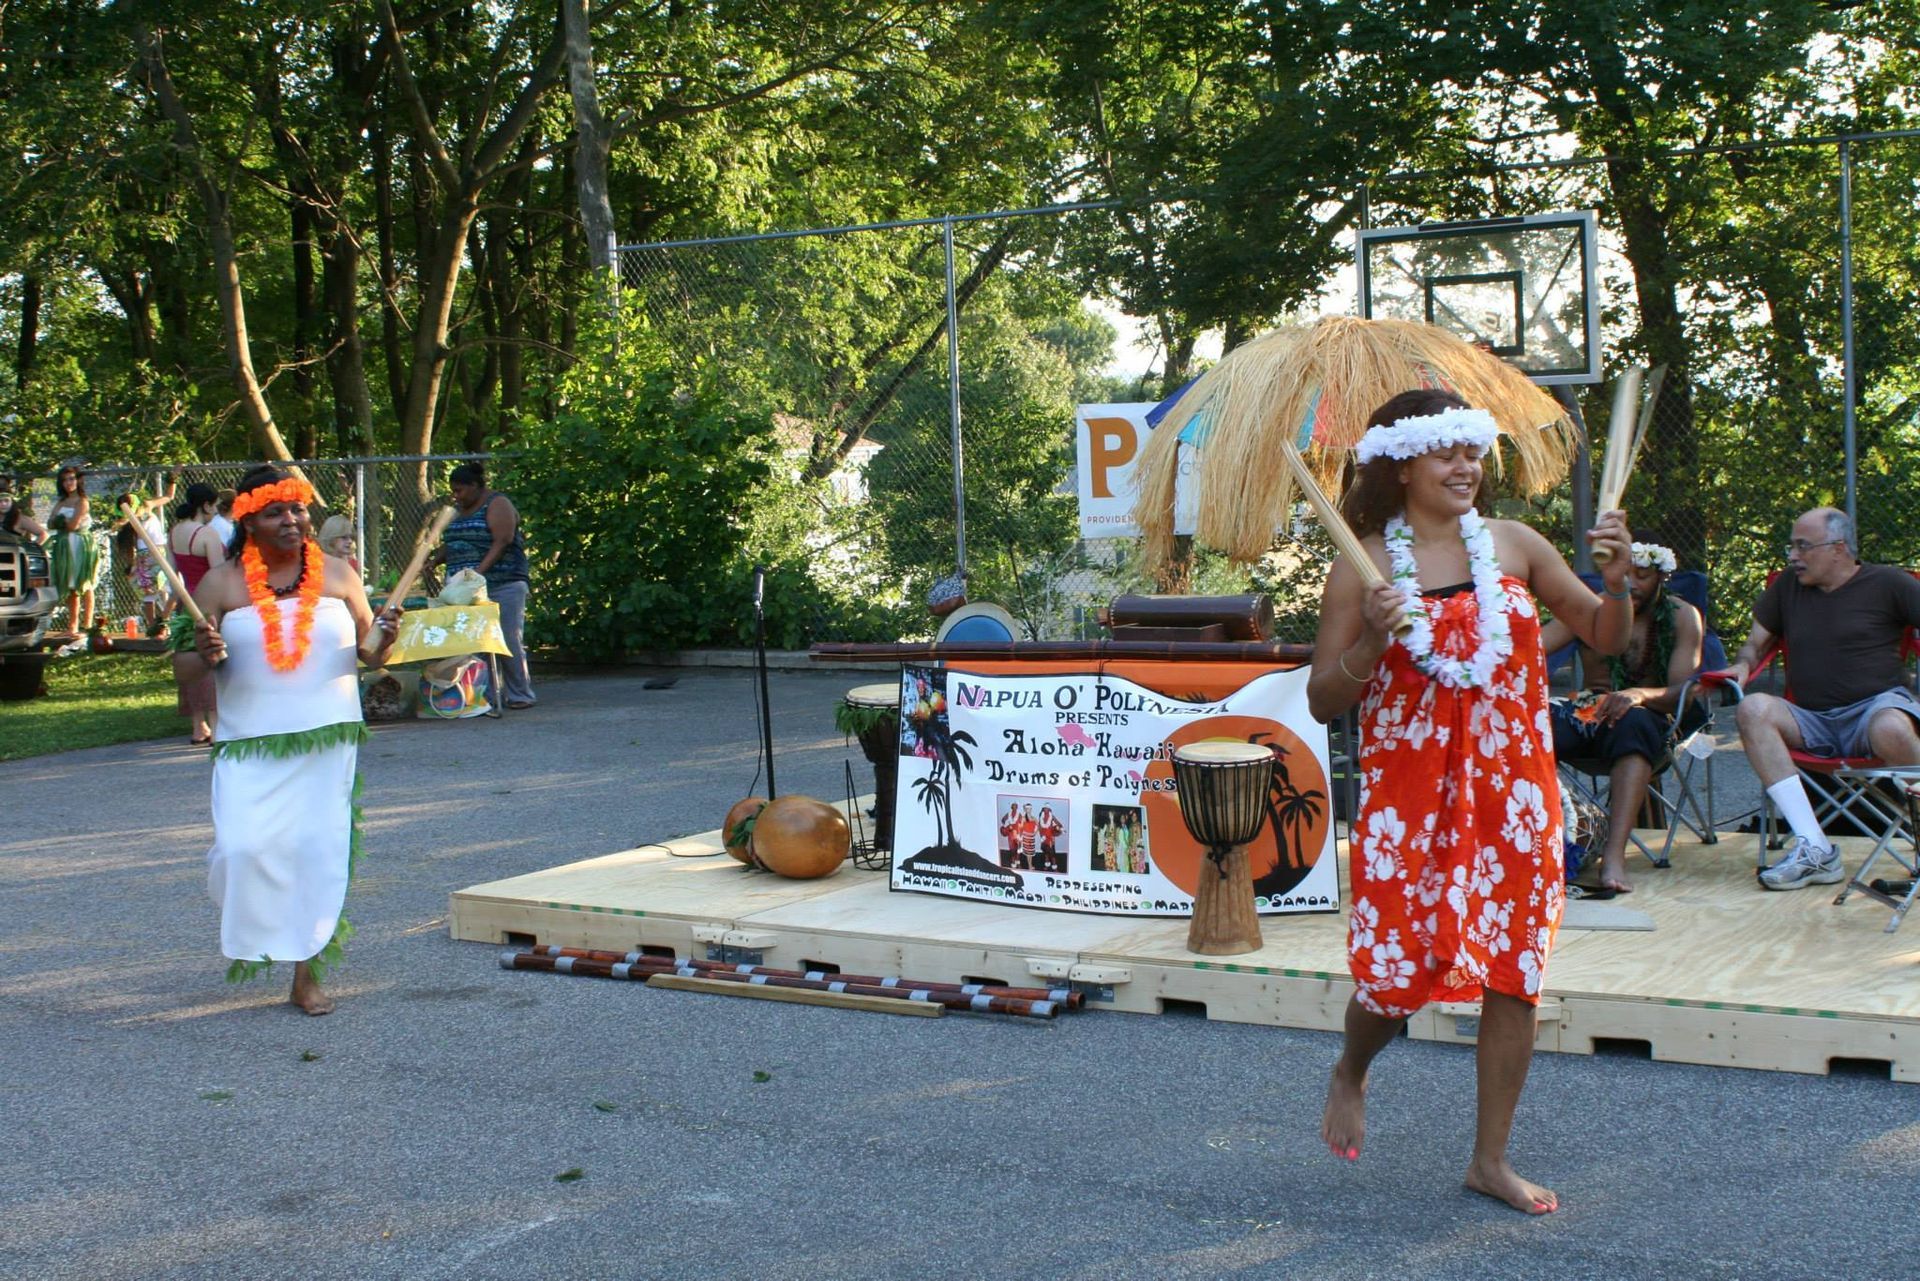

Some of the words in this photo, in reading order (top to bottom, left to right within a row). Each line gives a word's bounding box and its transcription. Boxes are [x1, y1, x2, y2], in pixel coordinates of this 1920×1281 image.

[956, 682, 1043, 708] NAPUA
[1054, 685, 1083, 709] O'
[1095, 685, 1229, 715] POLYNESIA
[1055, 712, 1129, 726] PRESENTS
[1003, 729, 1085, 756] Aloha
[985, 760, 1059, 785] Drums
[1068, 770, 1091, 787] of
[903, 874, 946, 890] HAWAII
[958, 880, 993, 896] TAHITI
[1272, 895, 1329, 908] SAMOA
[1045, 877, 1142, 895] REPRESENTING
